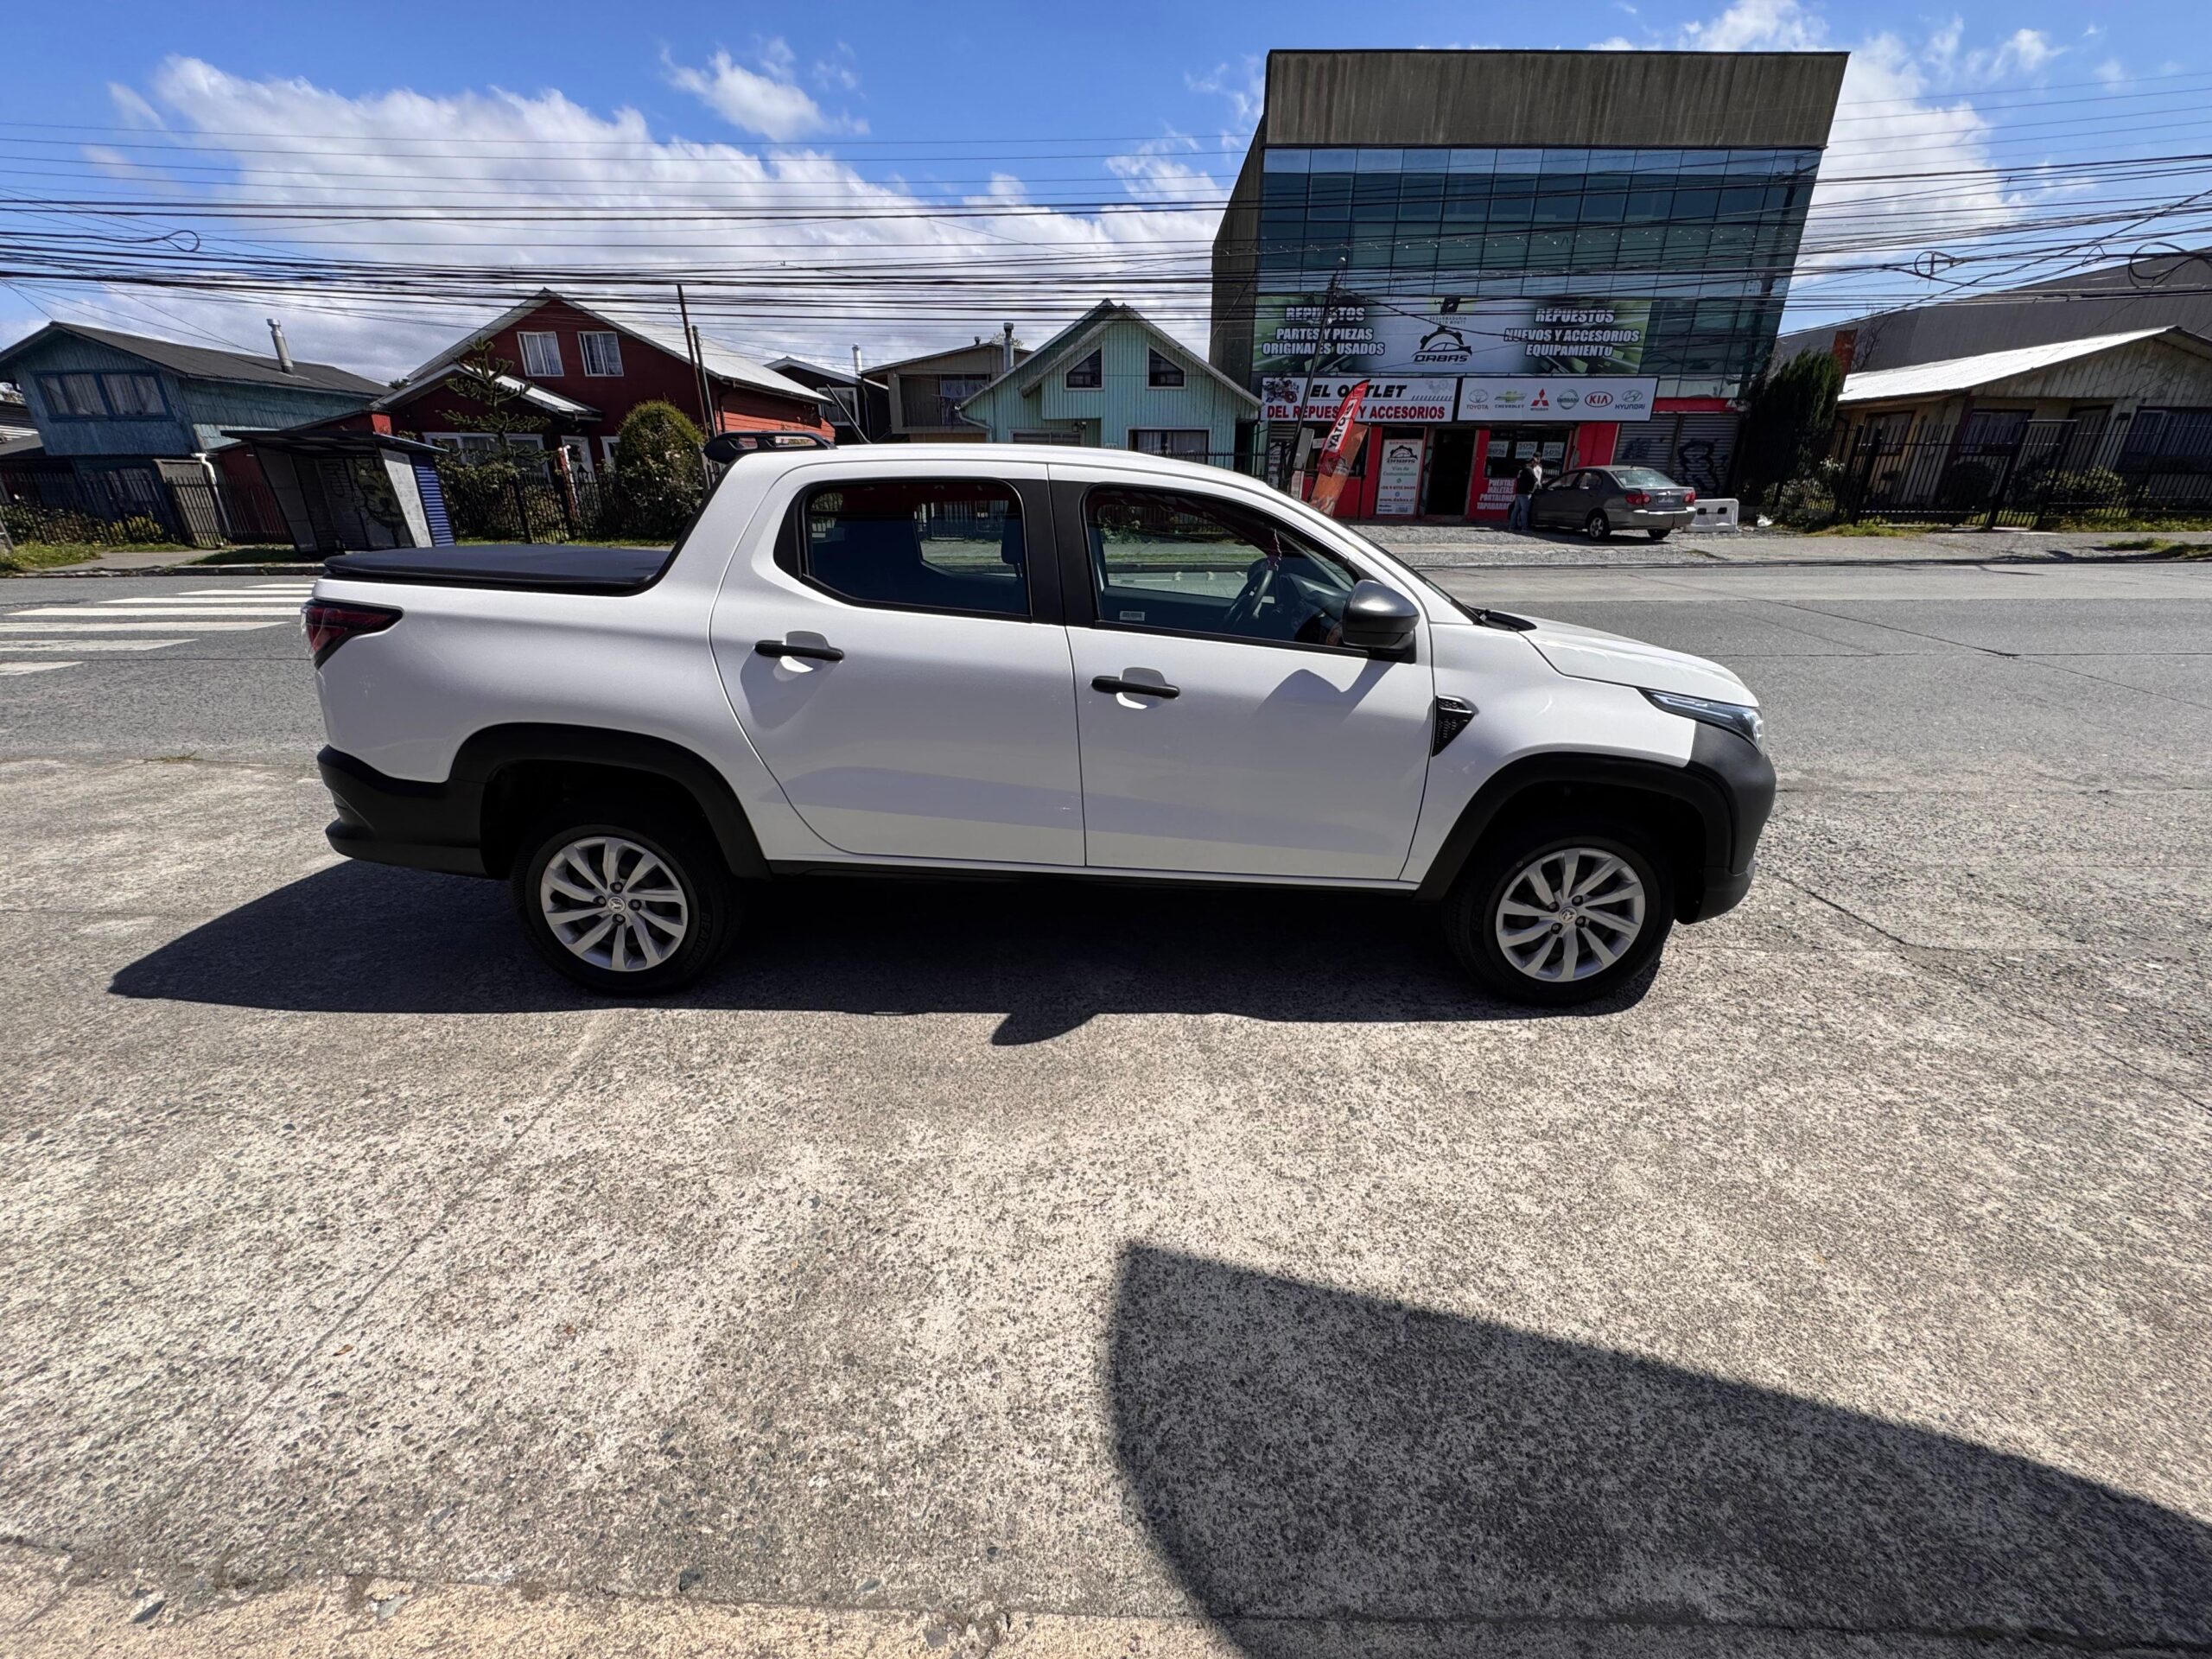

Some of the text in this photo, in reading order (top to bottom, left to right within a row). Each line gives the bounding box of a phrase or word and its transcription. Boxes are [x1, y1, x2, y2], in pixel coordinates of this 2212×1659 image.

[1285, 307, 1365, 321] REPUSTOS
[1535, 308, 1615, 322] REPUESTOS
[1276, 327, 1374, 340] PARTES Y PIEZAS
[1503, 329, 1640, 342] NUEVOS Y ACCESORIOS
[1336, 342, 1386, 355] USADOS
[1525, 344, 1614, 357] EQUIPAMIENTO
[1414, 354, 1469, 363] DABAS
[1310, 384, 1407, 397] EL OTLET
[1588, 395, 1609, 404] KIA
[1267, 405, 1289, 418] DEL
[1293, 405, 1341, 419] REPUES
[1358, 406, 1367, 419] Y
[1369, 406, 1446, 419] ACCESORIOS
[1328, 416, 1346, 448] YATO
